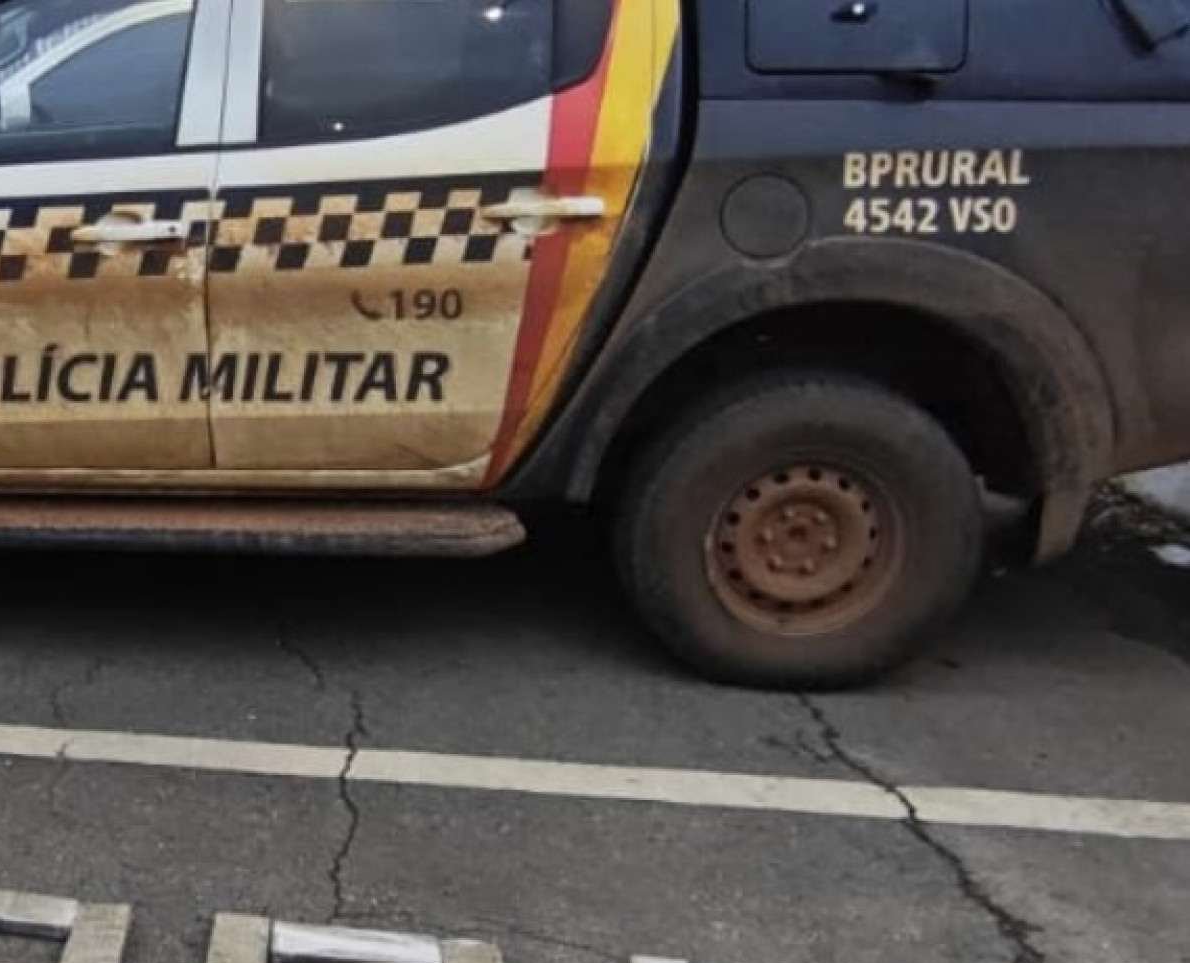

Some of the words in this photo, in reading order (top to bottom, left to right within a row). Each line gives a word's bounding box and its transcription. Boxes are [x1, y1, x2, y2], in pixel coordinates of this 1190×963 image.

[843, 149, 1031, 188] BPRURAL
[844, 197, 939, 233] 4542
[390, 288, 463, 321] 190
[179, 350, 450, 403] MILITAR
